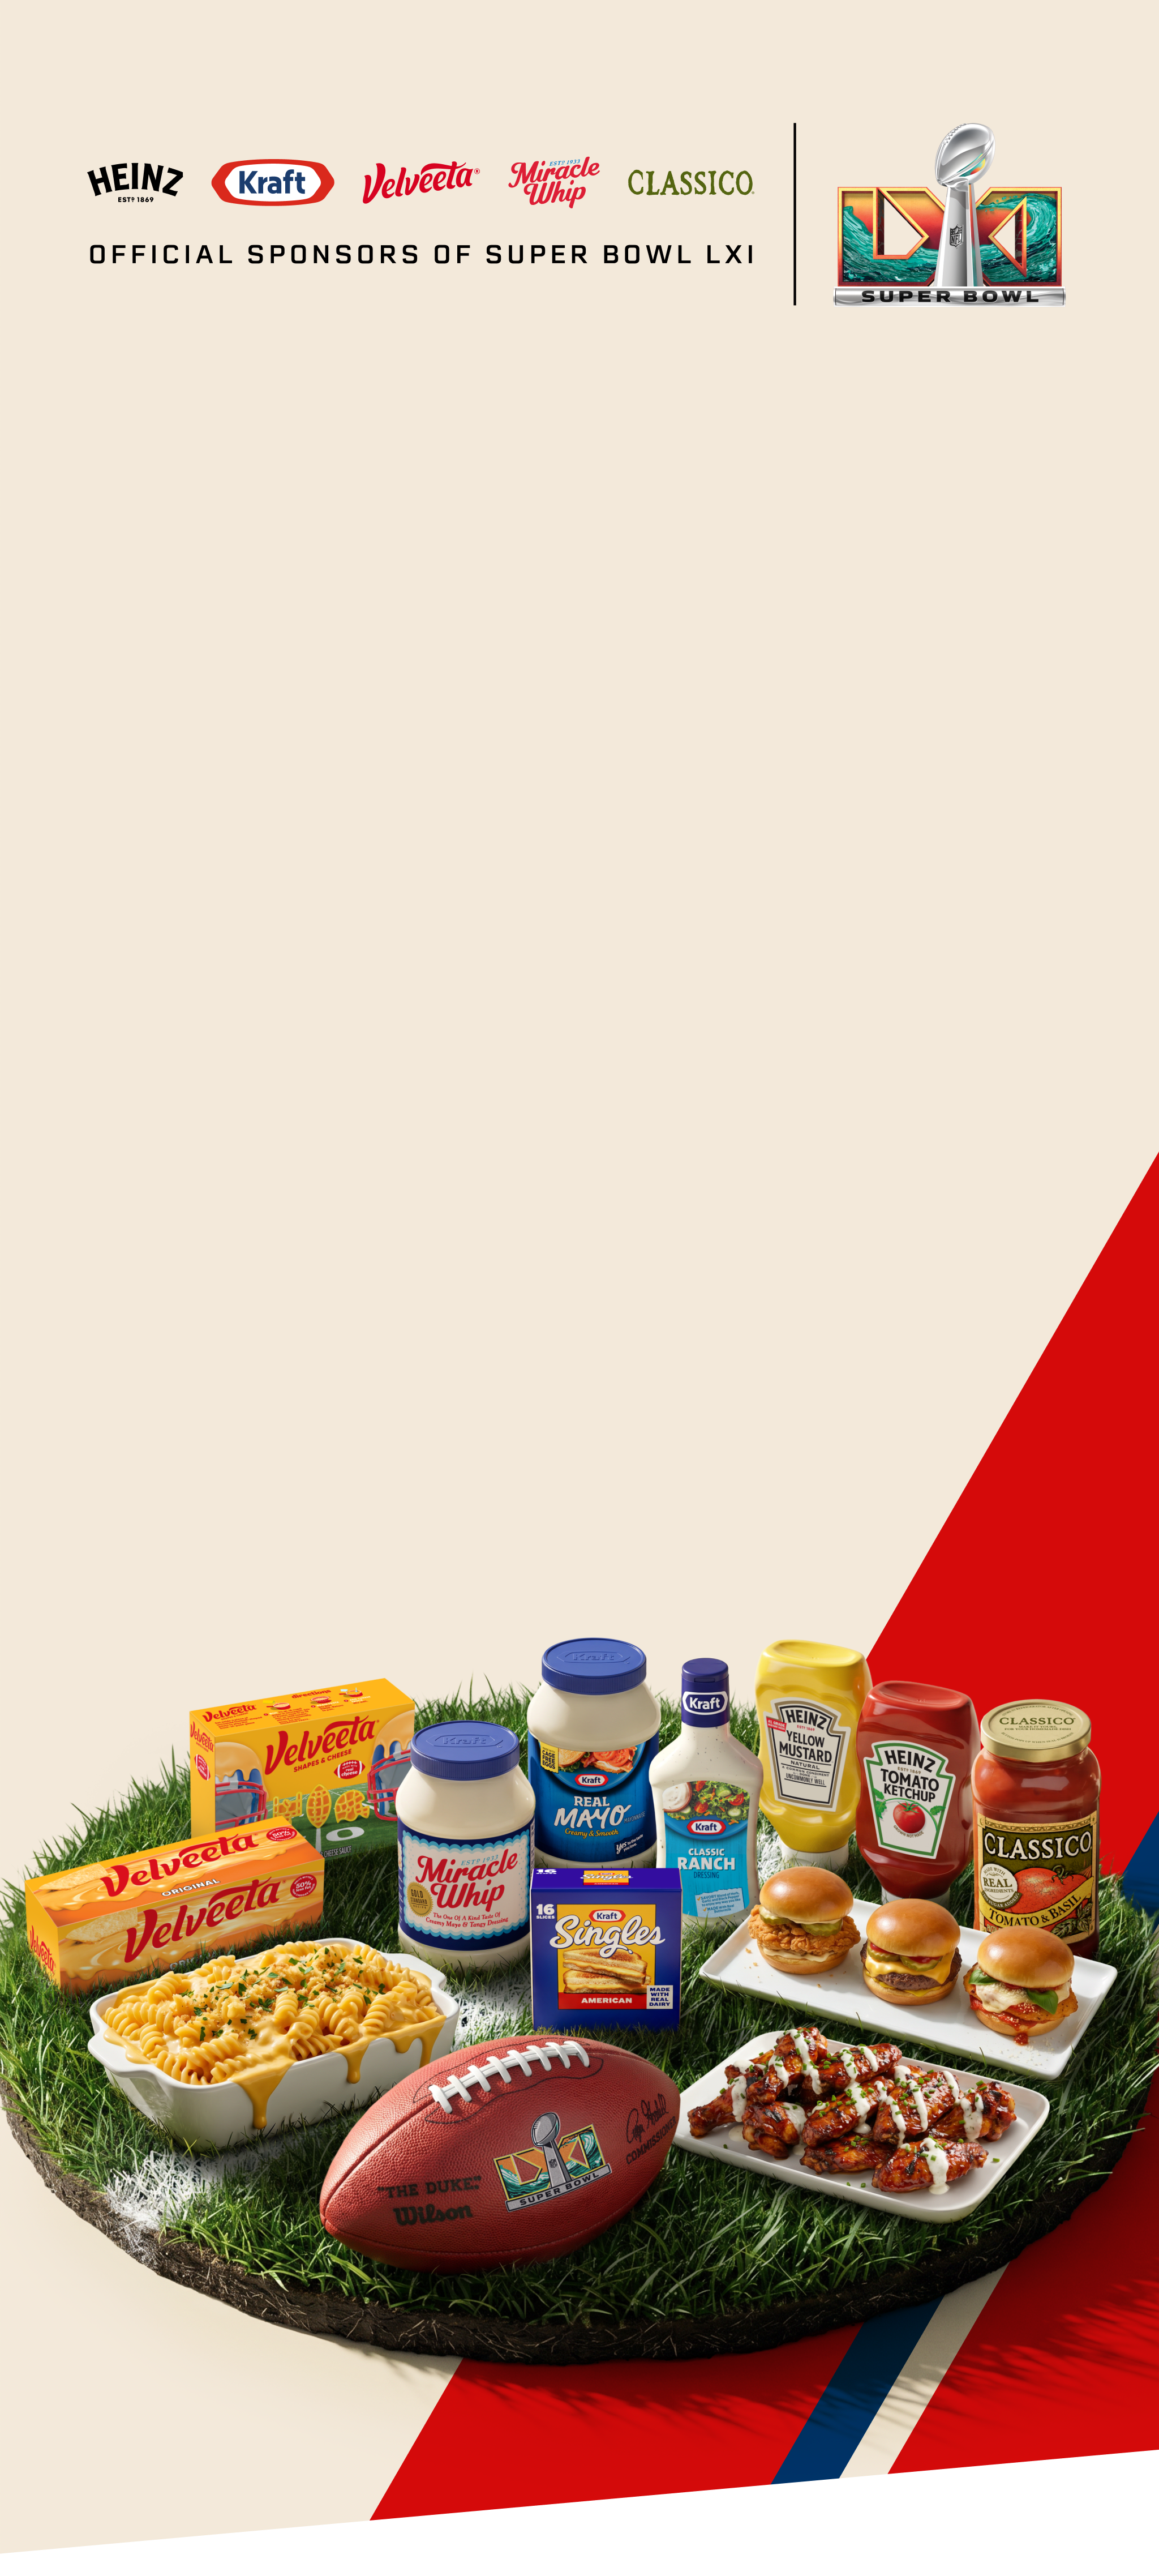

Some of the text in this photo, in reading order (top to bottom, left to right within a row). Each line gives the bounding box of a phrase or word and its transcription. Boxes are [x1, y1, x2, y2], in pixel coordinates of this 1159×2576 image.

[291, 1689, 332, 1699] directions
[689, 1697, 720, 1710] Kraft
[202, 1704, 257, 1722] Velveeta
[785, 1709, 827, 1730] HEINZ
[190, 1721, 213, 1752] Velveeta
[265, 1715, 375, 1775] Velveeta
[786, 1730, 825, 1748] YELLOW
[294, 1758, 320, 1772] SHAPES
[327, 1749, 352, 1761] CHEESE
[542, 1750, 555, 1758] CAGE
[542, 1755, 555, 1764] FREE
[779, 1741, 832, 1763] MUSTARD
[884, 1749, 935, 1773] HEINZ
[542, 1760, 555, 1769] EGGS
[791, 1760, 820, 1770] NATURAL
[785, 1773, 813, 1783] UNCOMMONLY
[881, 1768, 939, 1791] TOMATO
[574, 1796, 610, 1807] REAL
[884, 1783, 935, 1803] KETCHUP
[553, 1804, 632, 1829] MAYO
[624, 1811, 645, 1824] MAYONNAISE
[565, 1828, 587, 1839] Creamy
[696, 1822, 717, 1831] Kraft
[894, 1825, 906, 1837] GROWN
[324, 1848, 338, 1858] CHEESE
[984, 1832, 1092, 1859] CLASSICO
[100, 1833, 259, 1897] Velveeta
[415, 1848, 518, 1883] Miracle
[483, 1854, 499, 1863] 1933
[677, 1857, 736, 1871] RANCH
[993, 1867, 1006, 1876] WITH
[161, 1878, 221, 1898] ORIGINAL
[296, 1880, 312, 1889] 50%
[982, 1877, 1012, 1888] REAL
[411, 1889, 423, 1898] GOLD
[430, 1879, 505, 1912] Whip
[536, 1904, 555, 1915] 16
[989, 1894, 1081, 1926] TOMATO & BASIL
[124, 1876, 281, 1963] Velveeta
[426, 1916, 444, 1927] Creamy
[487, 1917, 509, 1926] Dressing
[549, 1915, 666, 1958] Singles
[29, 1925, 55, 1976] Velveeta
[626, 2116, 677, 2166] COMMISSIONER
[520, 2172, 600, 2206] SUPER BOWL
[393, 2204, 473, 2226] Wilson
